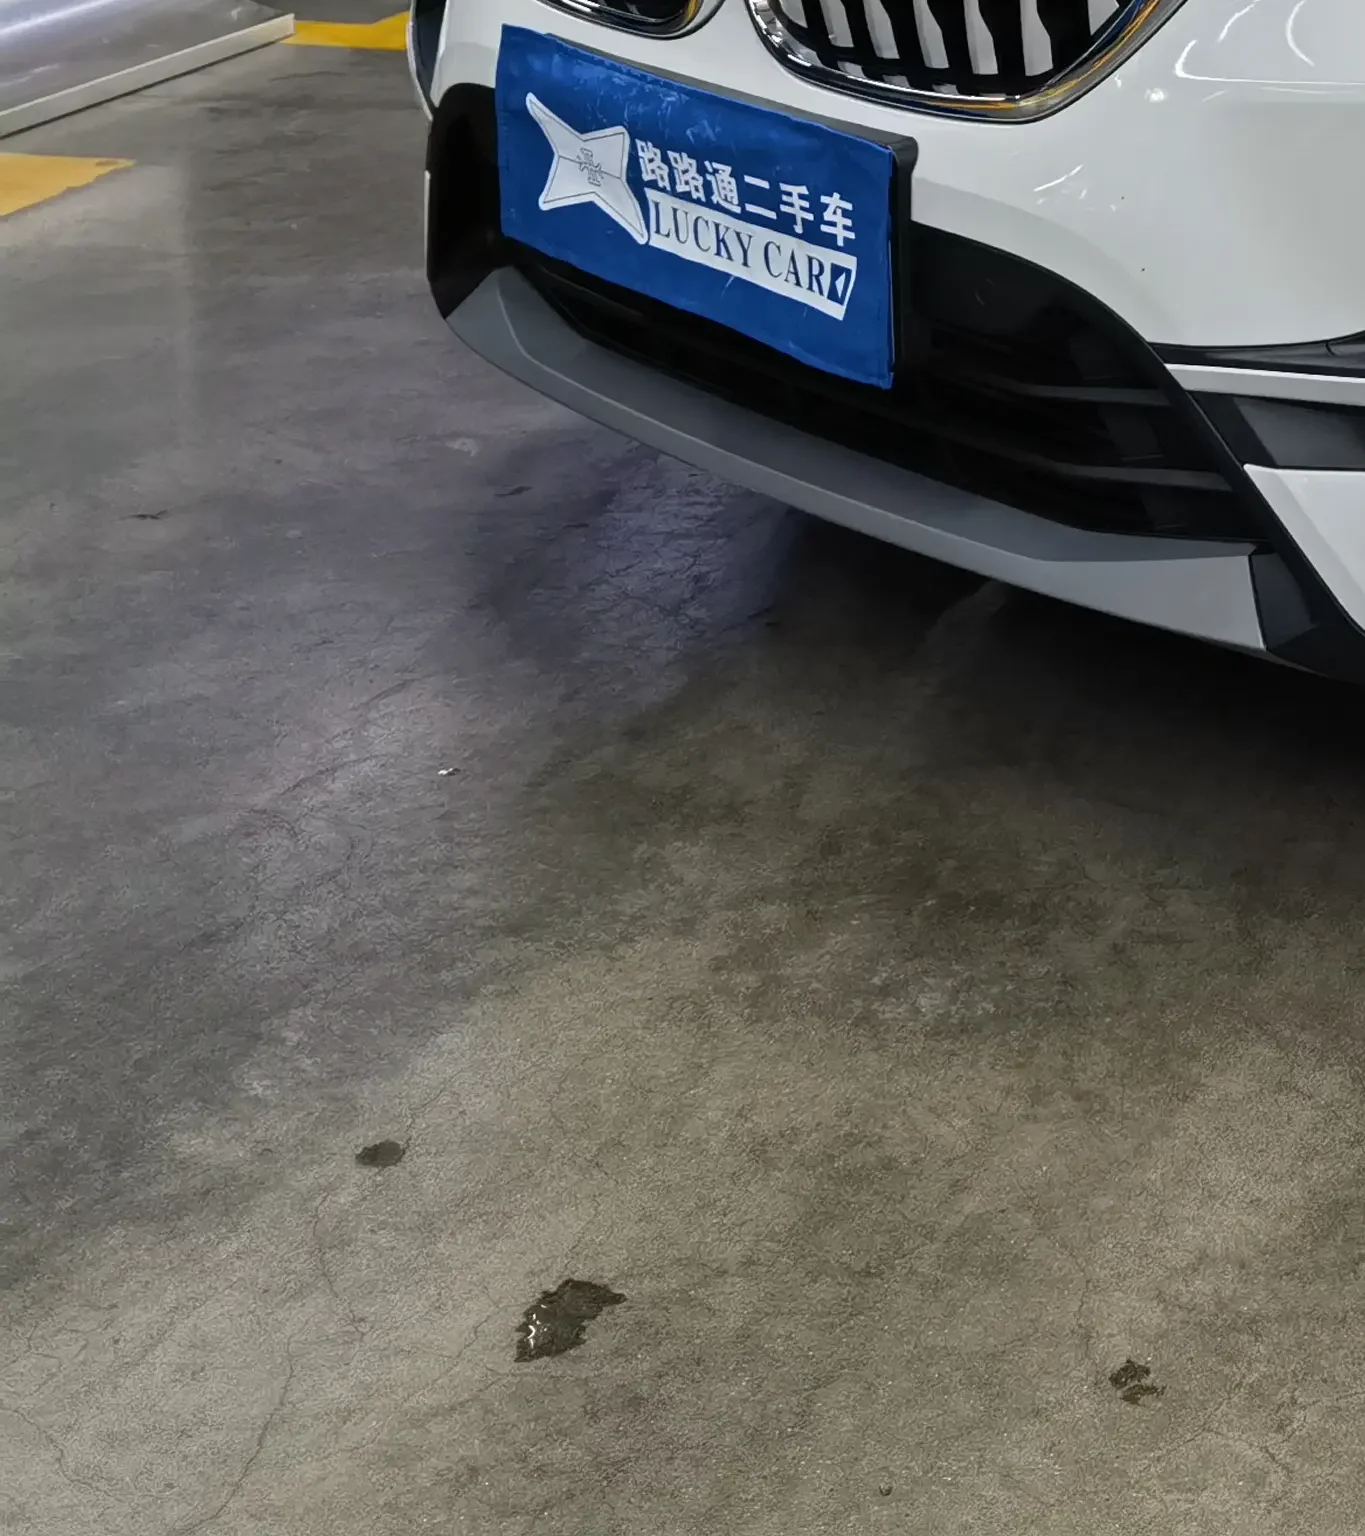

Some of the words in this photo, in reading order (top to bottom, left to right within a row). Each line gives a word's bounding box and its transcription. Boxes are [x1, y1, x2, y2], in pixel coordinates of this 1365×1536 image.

[634, 138, 856, 247] 路路通二手车
[653, 201, 754, 268] LUCKY
[764, 240, 829, 298] CAR
